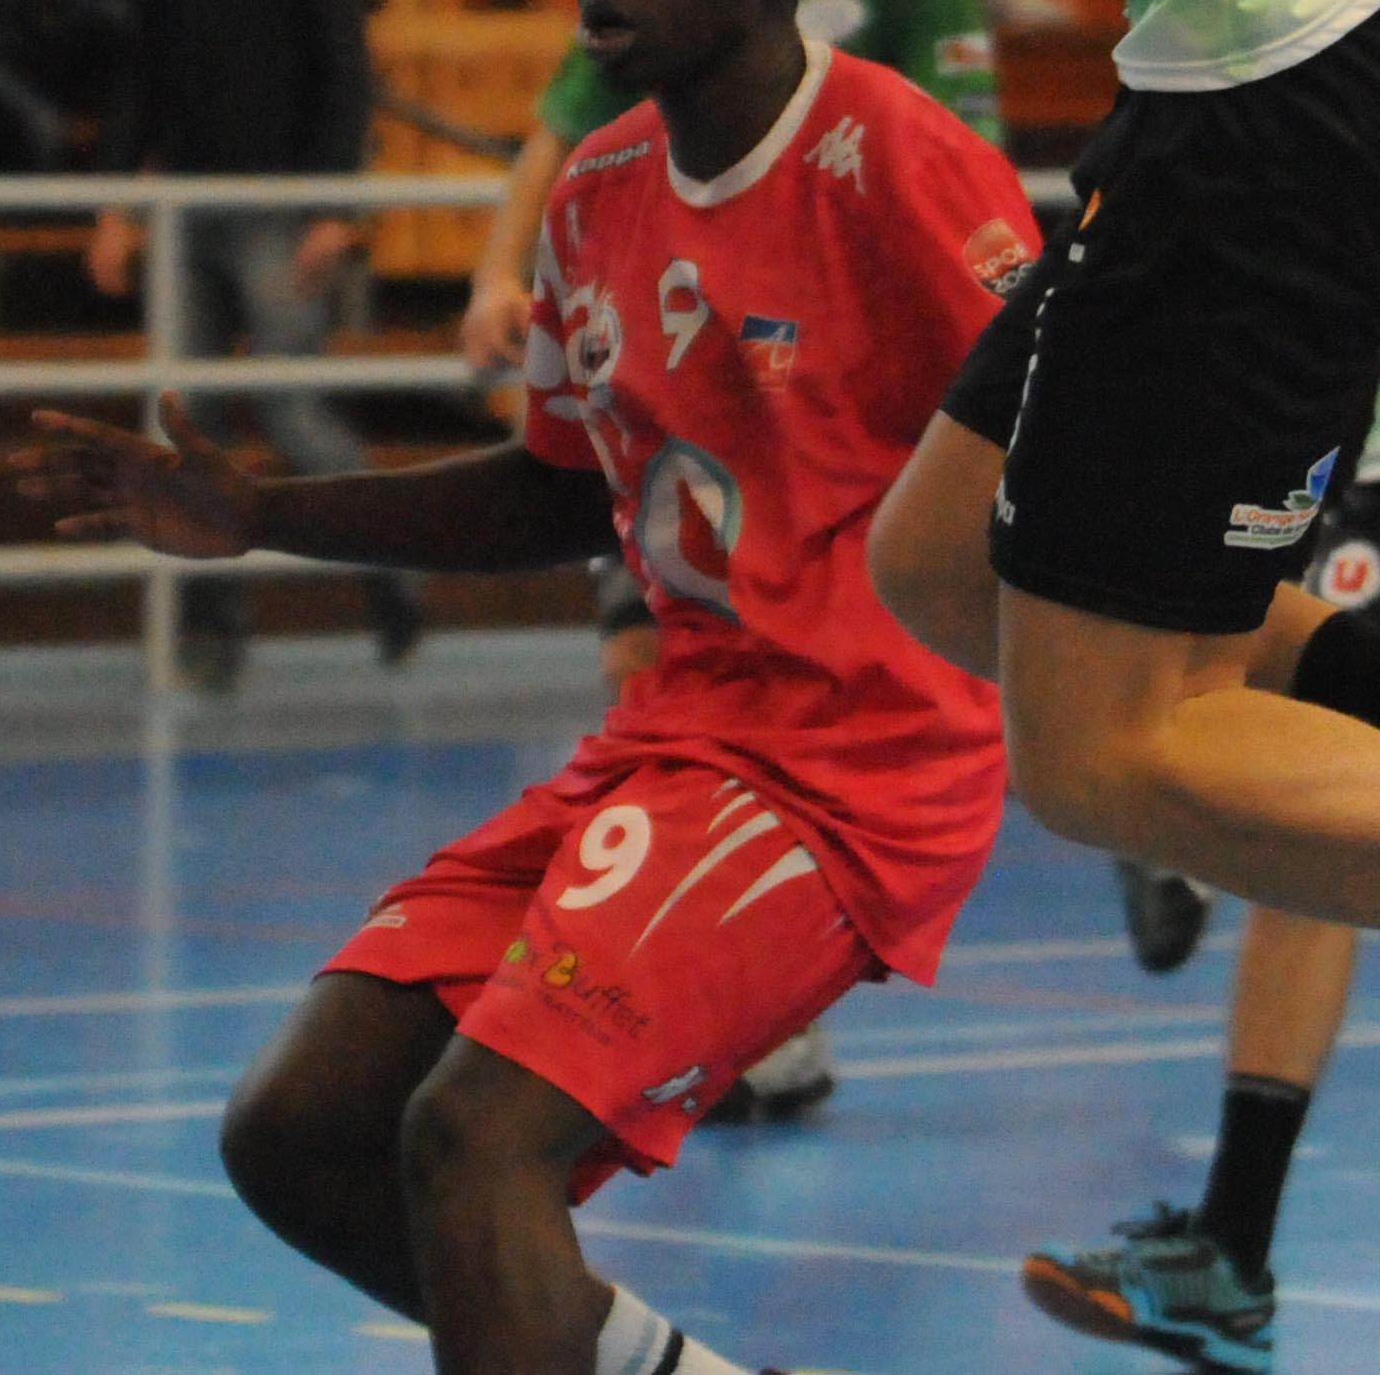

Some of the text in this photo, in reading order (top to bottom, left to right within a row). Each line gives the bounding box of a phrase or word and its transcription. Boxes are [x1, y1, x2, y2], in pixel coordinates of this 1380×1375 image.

[658, 257, 712, 371] 9
[1331, 559, 1371, 592] U
[555, 805, 651, 910] 9
